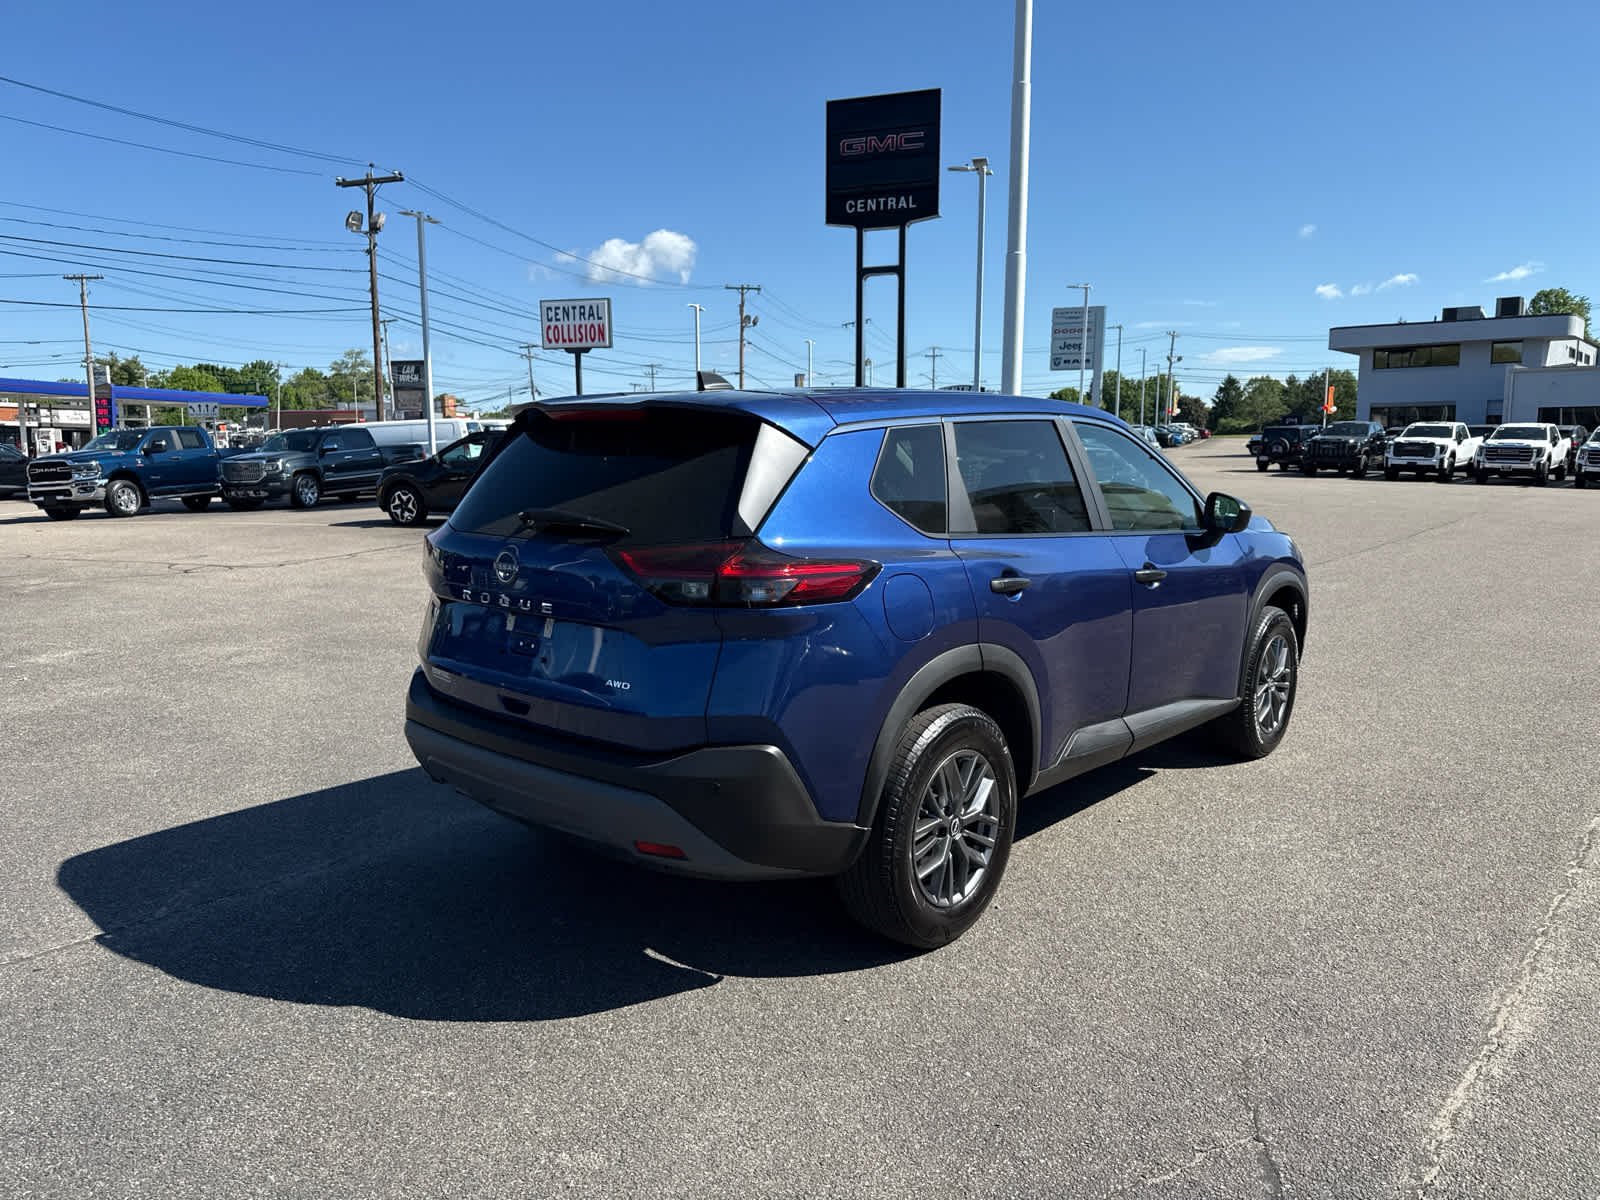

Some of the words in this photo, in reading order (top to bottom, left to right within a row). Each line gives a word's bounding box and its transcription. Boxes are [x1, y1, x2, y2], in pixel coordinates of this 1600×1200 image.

[840, 131, 925, 156] GMC
[845, 195, 917, 214] CENTRAL
[546, 304, 603, 322] CENTRAL
[545, 322, 605, 344] COLLISION
[462, 589, 553, 613] ROGUE
[605, 679, 631, 690] AWD
